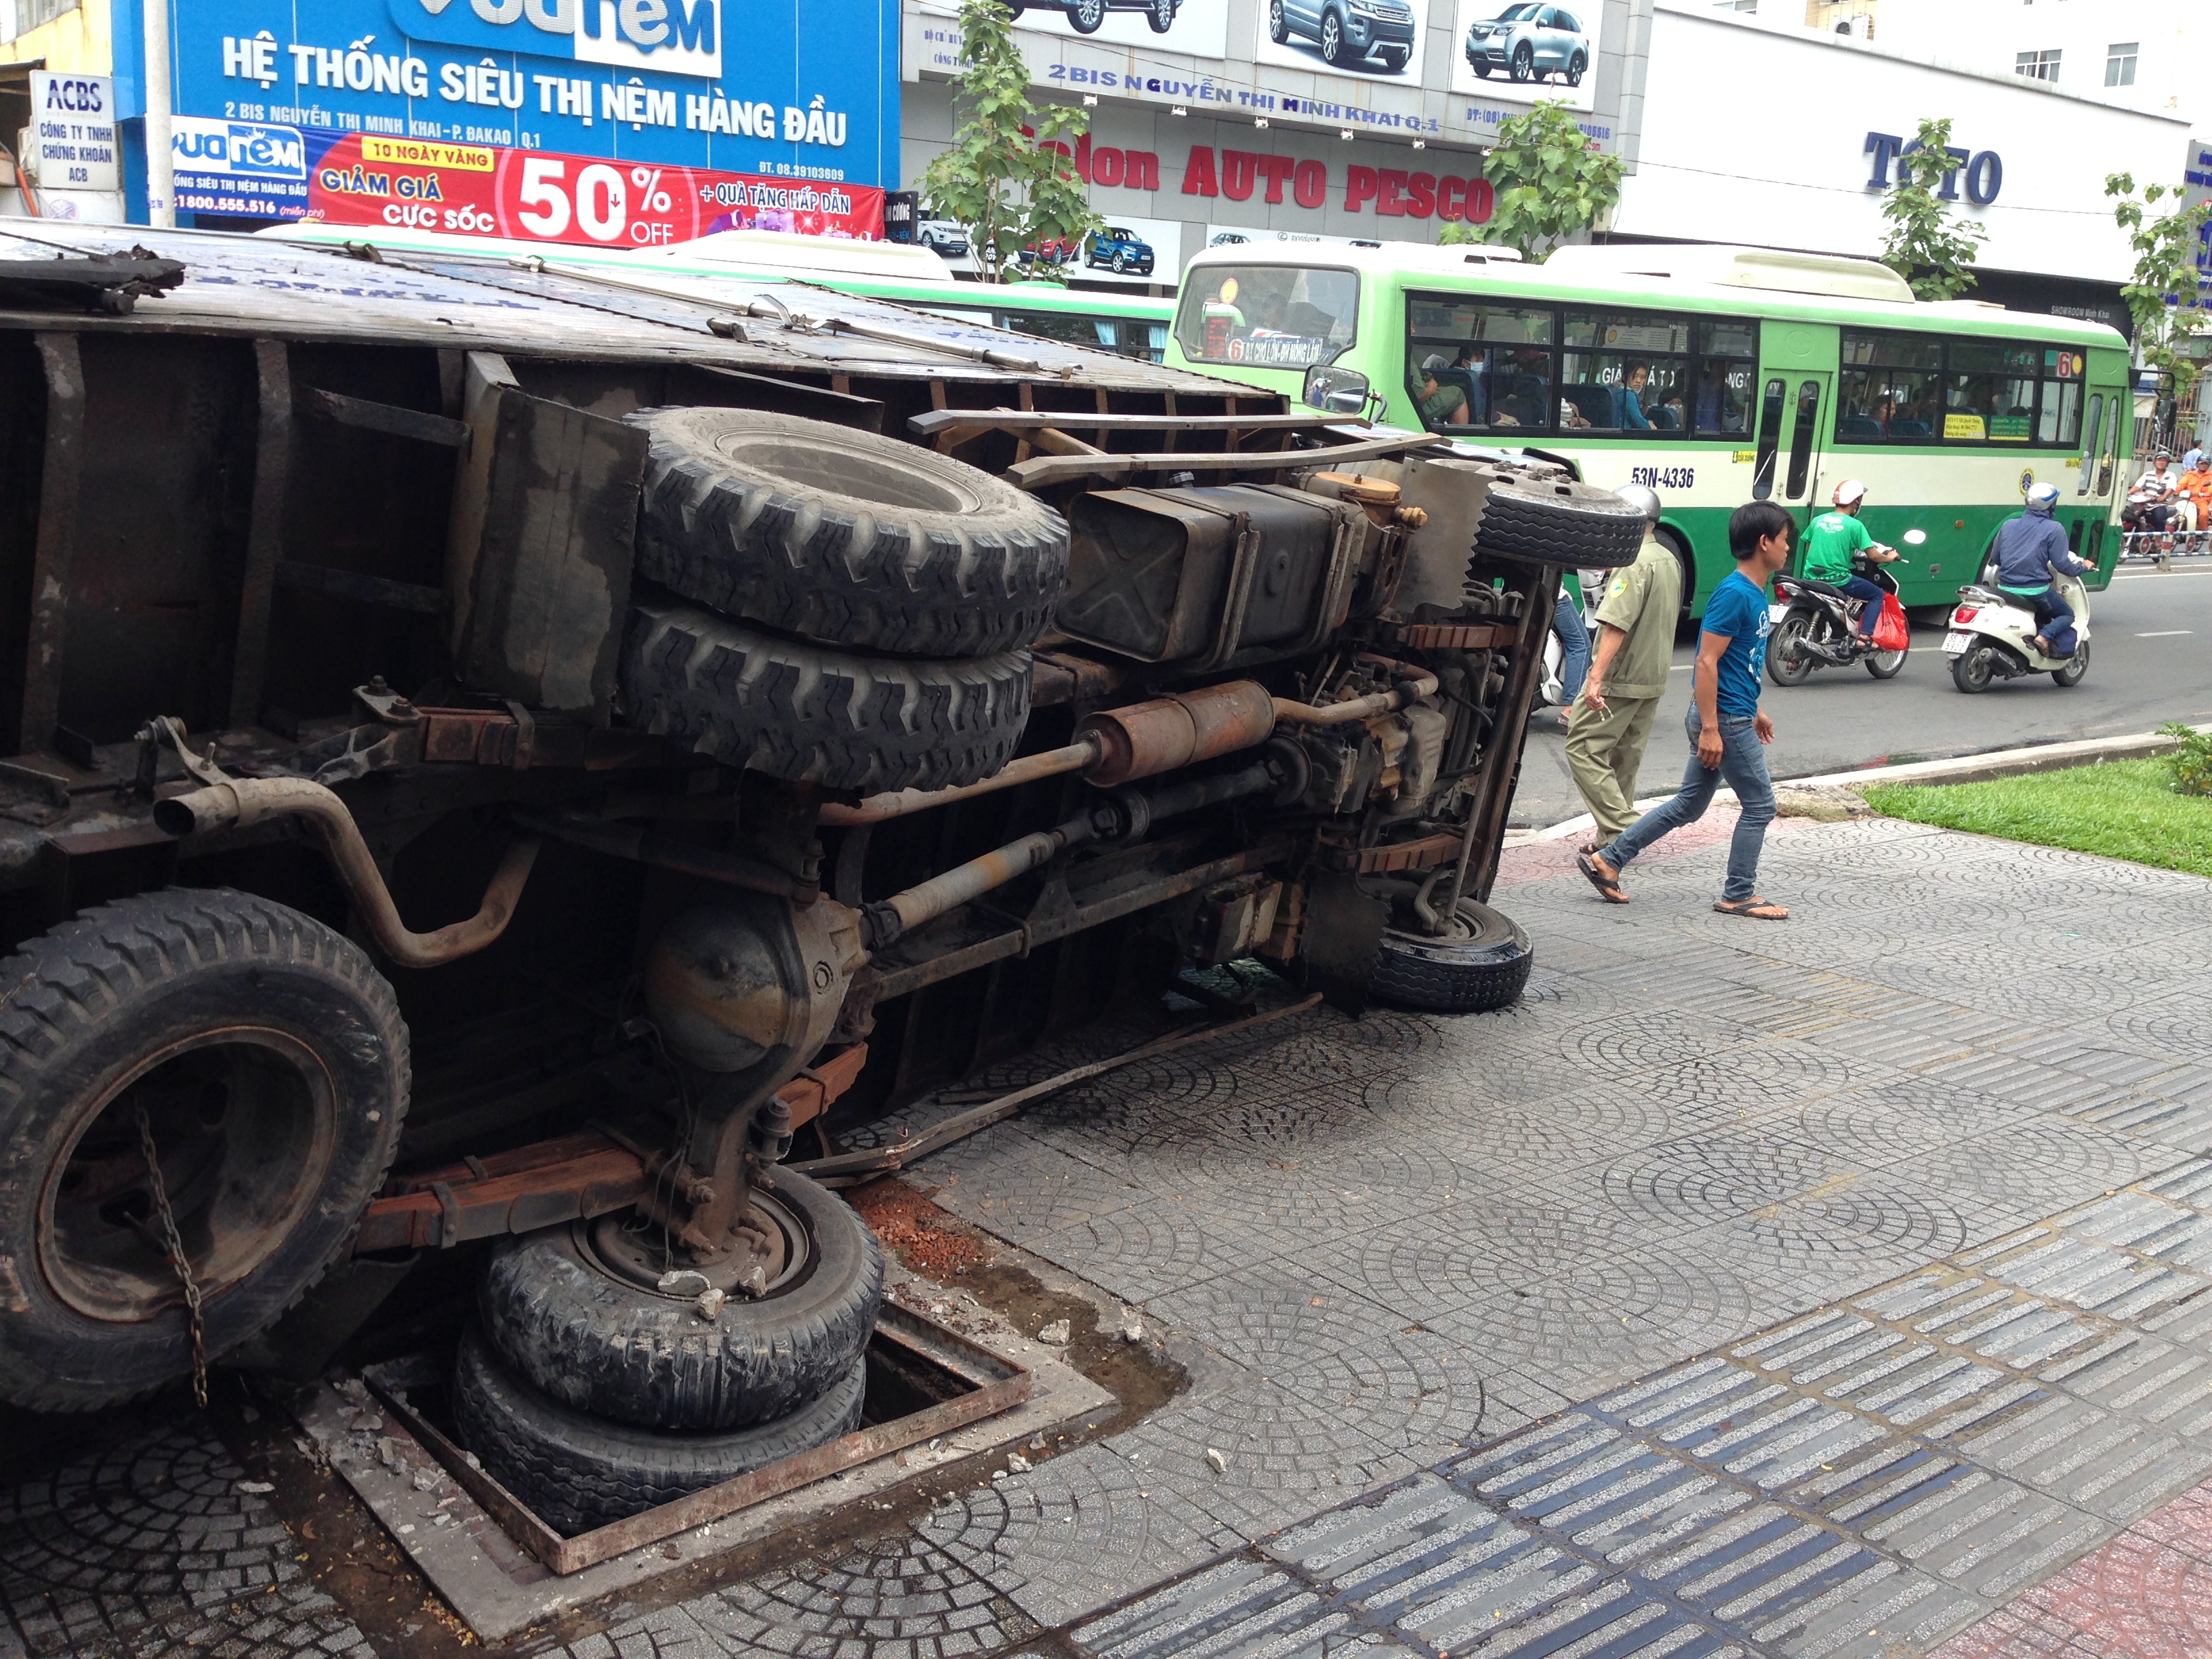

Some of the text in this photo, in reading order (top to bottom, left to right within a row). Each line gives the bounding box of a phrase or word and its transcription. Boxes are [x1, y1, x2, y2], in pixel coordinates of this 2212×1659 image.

[47, 79, 102, 112] ACBS
[223, 30, 846, 146] HỆ THỐNG SIÊU THỊ NỆM HÀNG ĐẦU
[1125, 75, 1232, 103] NGUYỄN
[1238, 91, 1274, 112] THỊ
[1283, 98, 1339, 118] MINH
[1346, 106, 1400, 126] KHAI
[40, 121, 112, 142] CÔNG TY TNHH
[225, 102, 235, 118] 2
[240, 103, 264, 121] BIS
[270, 104, 331, 127] NGUYỄN
[337, 112, 361, 132] THỊ
[365, 115, 403, 134] MINH
[466, 130, 512, 145] ĐAKAO
[521, 132, 540, 148] Q.1
[43, 142, 112, 163] CHỨNG KHOÁN
[373, 143, 488, 167] 10 NGÀY VÀNG
[69, 167, 87, 182] ACB
[321, 165, 443, 201] GIẢM GIÁ
[777, 163, 844, 181] 08.39103609
[1010, 124, 1494, 224] lon AUTO PESCO
[174, 173, 194, 188] ỐNG
[197, 176, 218, 190] SIÊU
[221, 180, 236, 193] THỊ
[238, 180, 258, 194] NỆM
[261, 181, 287, 195] HÀNG
[716, 181, 746, 206] QUÀ
[749, 183, 787, 211] TẶNG
[790, 186, 817, 211] HẤP
[822, 188, 851, 215] DẪN
[444, 204, 495, 232] SỐC
[630, 222, 674, 245] OFF
[2051, 305, 2085, 316] SHOWROOM
[1231, 340, 1242, 361] 6
[1601, 363, 1622, 384] GIẢ
[2058, 352, 2070, 377] 6
[1631, 467, 1694, 489] 53N-4336
